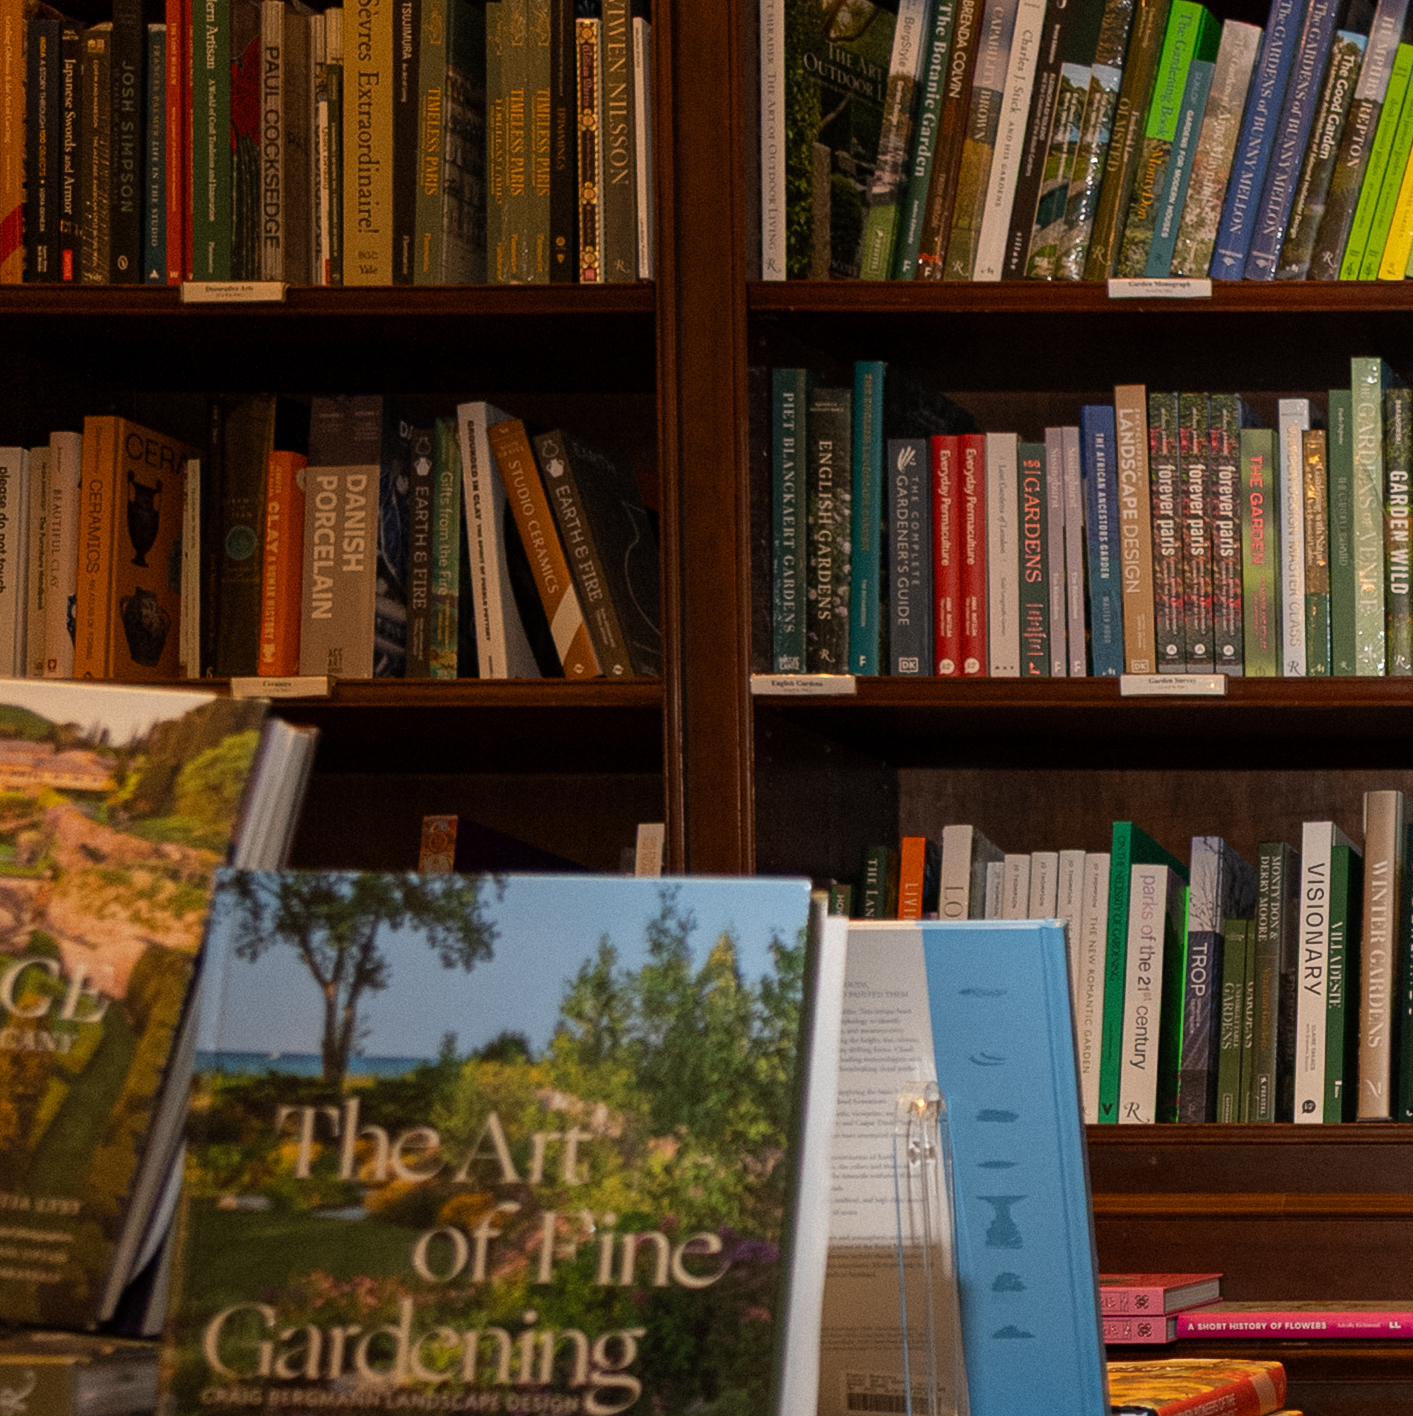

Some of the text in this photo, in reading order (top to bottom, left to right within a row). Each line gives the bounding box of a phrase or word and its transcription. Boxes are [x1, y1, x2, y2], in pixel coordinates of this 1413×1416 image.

[64, 59, 74, 215] Japanese Swords and Armor
[121, 60, 133, 213] JOSH SIMPSON
[265, 47, 279, 249] PAUL COCKSEDGE
[609, 82, 628, 185] NILSSON
[914, 2, 953, 177] The Botanic Garden
[1106, 98, 1129, 172] OLMSTED
[1262, 3, 1329, 236] The GARDENS of BUNNY MELLON
[1346, 16, 1395, 168] HUMPHRY REPTON
[357, 72, 379, 233] Extraordinaire!
[87, 479, 103, 574] CERAMICS
[312, 474, 338, 618] PORCELAIN
[342, 474, 367, 571] DANISH
[506, 460, 559, 594] STUDIO CERAMICS
[554, 485, 580, 543] EARTH
[579, 562, 603, 602] FIRE
[783, 393, 795, 633] PIET BLANCKAERT GARDENS
[817, 441, 833, 620] ENGLISH GARDENS
[896, 476, 909, 625] GARDENER'S GUIDE
[1024, 478, 1041, 583] GARDENS
[1218, 465, 1237, 556] forever paris
[1390, 471, 1408, 594] GARDEN WILD
[1140, 875, 1157, 920] parks
[1140, 925, 1155, 941] of
[1304, 863, 1325, 995] VISIONARY
[1368, 860, 1388, 1047] WINTER GARDENS
[1140, 945, 1155, 972] the
[1191, 943, 1207, 996] TROP
[1130, 1006, 1150, 1069] century
[277, 1096, 592, 1186] The Art
[412, 1200, 732, 1289] of Fine
[1230, 1322, 1267, 1330] HISTORY
[1270, 1322, 1281, 1330] OF
[1285, 1322, 1326, 1330] FLOWERS
[507, 1394, 579, 1415] DESIGN
